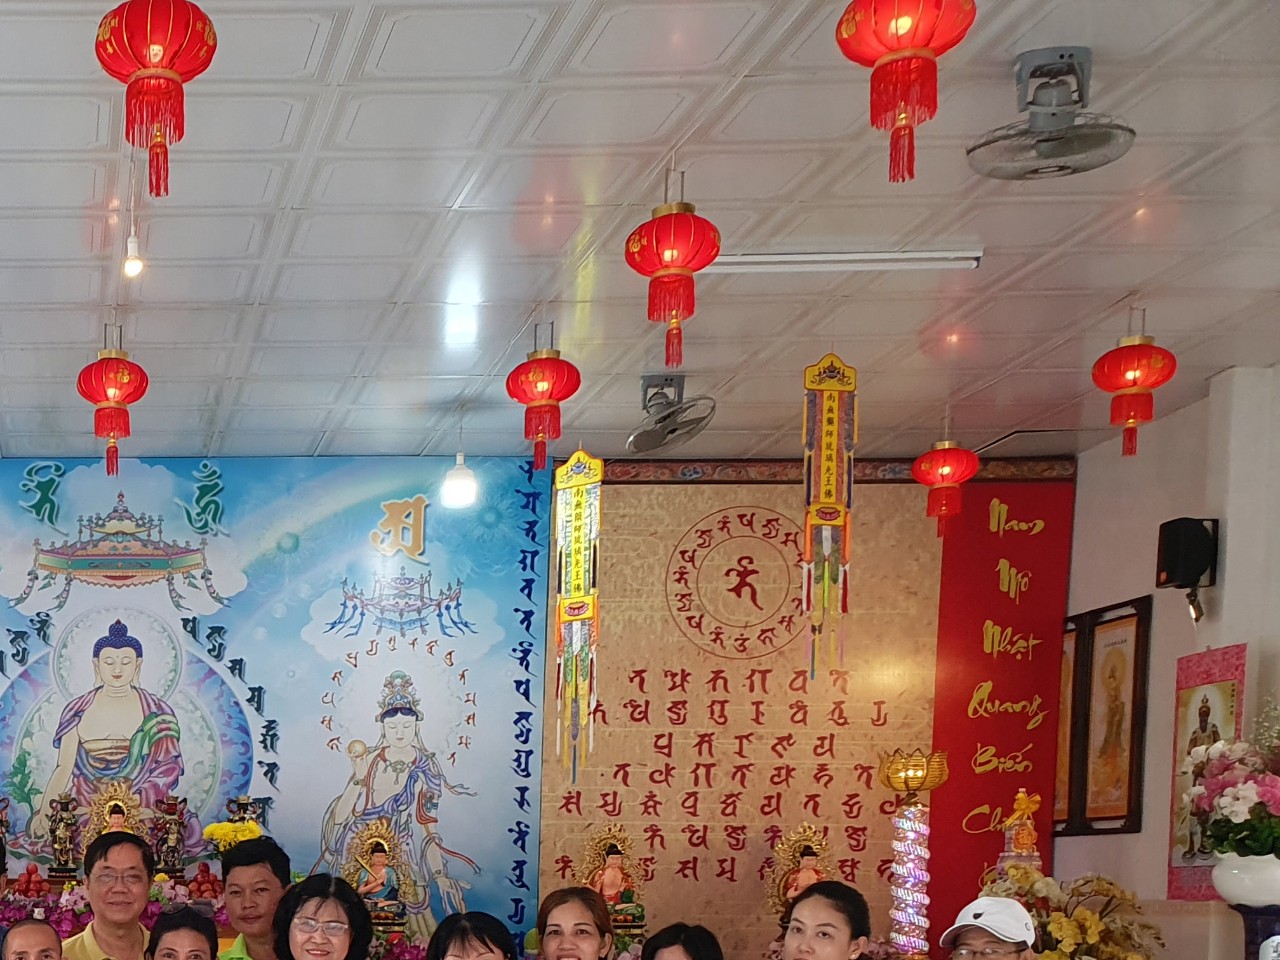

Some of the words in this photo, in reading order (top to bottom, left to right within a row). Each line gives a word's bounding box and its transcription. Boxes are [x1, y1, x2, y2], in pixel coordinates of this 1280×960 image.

[989, 497, 1045, 538] Nam
[983, 619, 1043, 661] Nhật
[967, 680, 1050, 730] Quang
[971, 742, 1033, 774] Biến
[962, 804, 1008, 834] Chi
